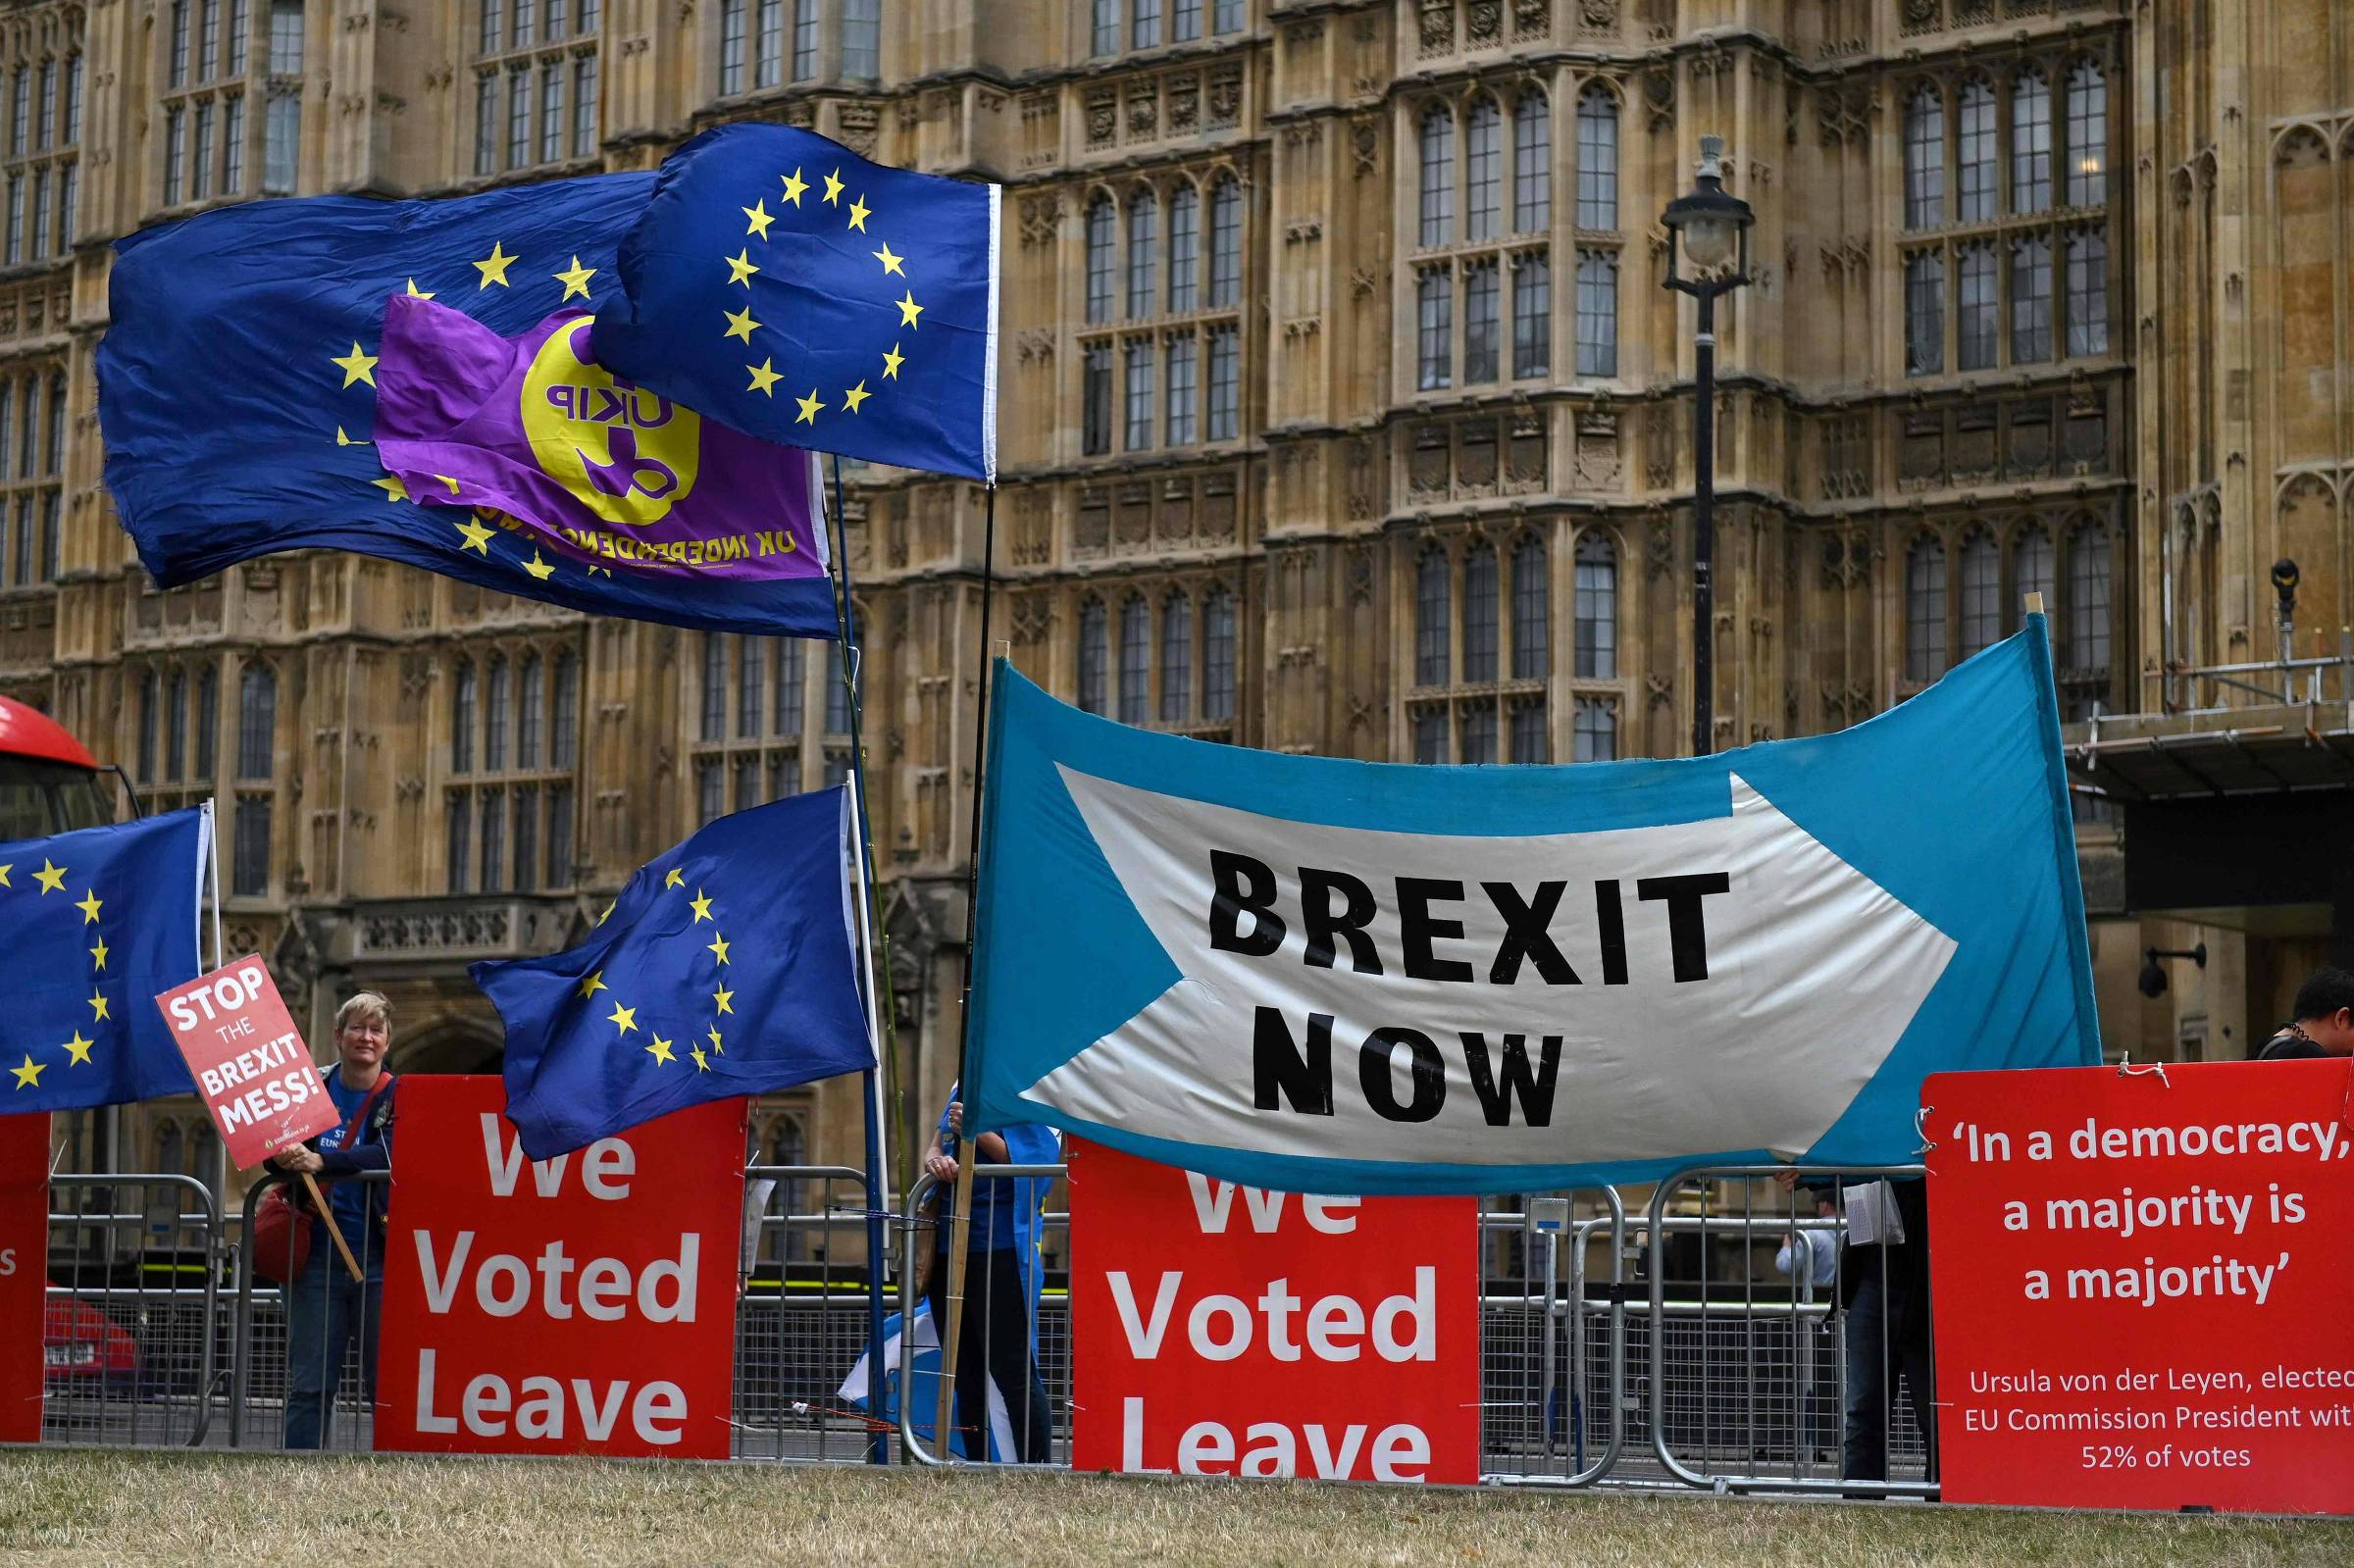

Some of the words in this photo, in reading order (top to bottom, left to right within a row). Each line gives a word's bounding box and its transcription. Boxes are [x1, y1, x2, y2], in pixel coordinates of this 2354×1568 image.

[1209, 849, 1729, 985] BREXIT
[169, 967, 263, 1031] STOP
[215, 1016, 255, 1044] THE
[200, 1033, 298, 1096] BREXIT
[1254, 1006, 1563, 1127] NOW
[218, 1067, 319, 1135] MESS!
[480, 1112, 637, 1200] We
[2028, 1132, 2053, 1160] a
[2069, 1118, 2350, 1162] democracy,
[1185, 1169, 1361, 1235] We
[2004, 1201, 2028, 1231] a
[2046, 1185, 2253, 1238] majority
[2269, 1183, 2306, 1224] is
[414, 1230, 699, 1322] Voted
[2024, 1271, 2050, 1300] a
[1106, 1266, 1436, 1362] Voted
[417, 1349, 687, 1444] Leave
[1970, 1369, 2051, 1393] Ursula
[2060, 1375, 2107, 1391] von
[2116, 1367, 2160, 1391] der
[2168, 1368, 2252, 1395] Leyen,
[1123, 1396, 1430, 1483] Leave
[1966, 1408, 1998, 1431] EU
[2008, 1406, 2166, 1431] Commission
[2175, 1403, 2302, 1429] President
[2309, 1404, 2354, 1427] wit
[2082, 1444, 2137, 1468] 52%
[2145, 1443, 2173, 1468] of
[2178, 1445, 2251, 1467] votes
